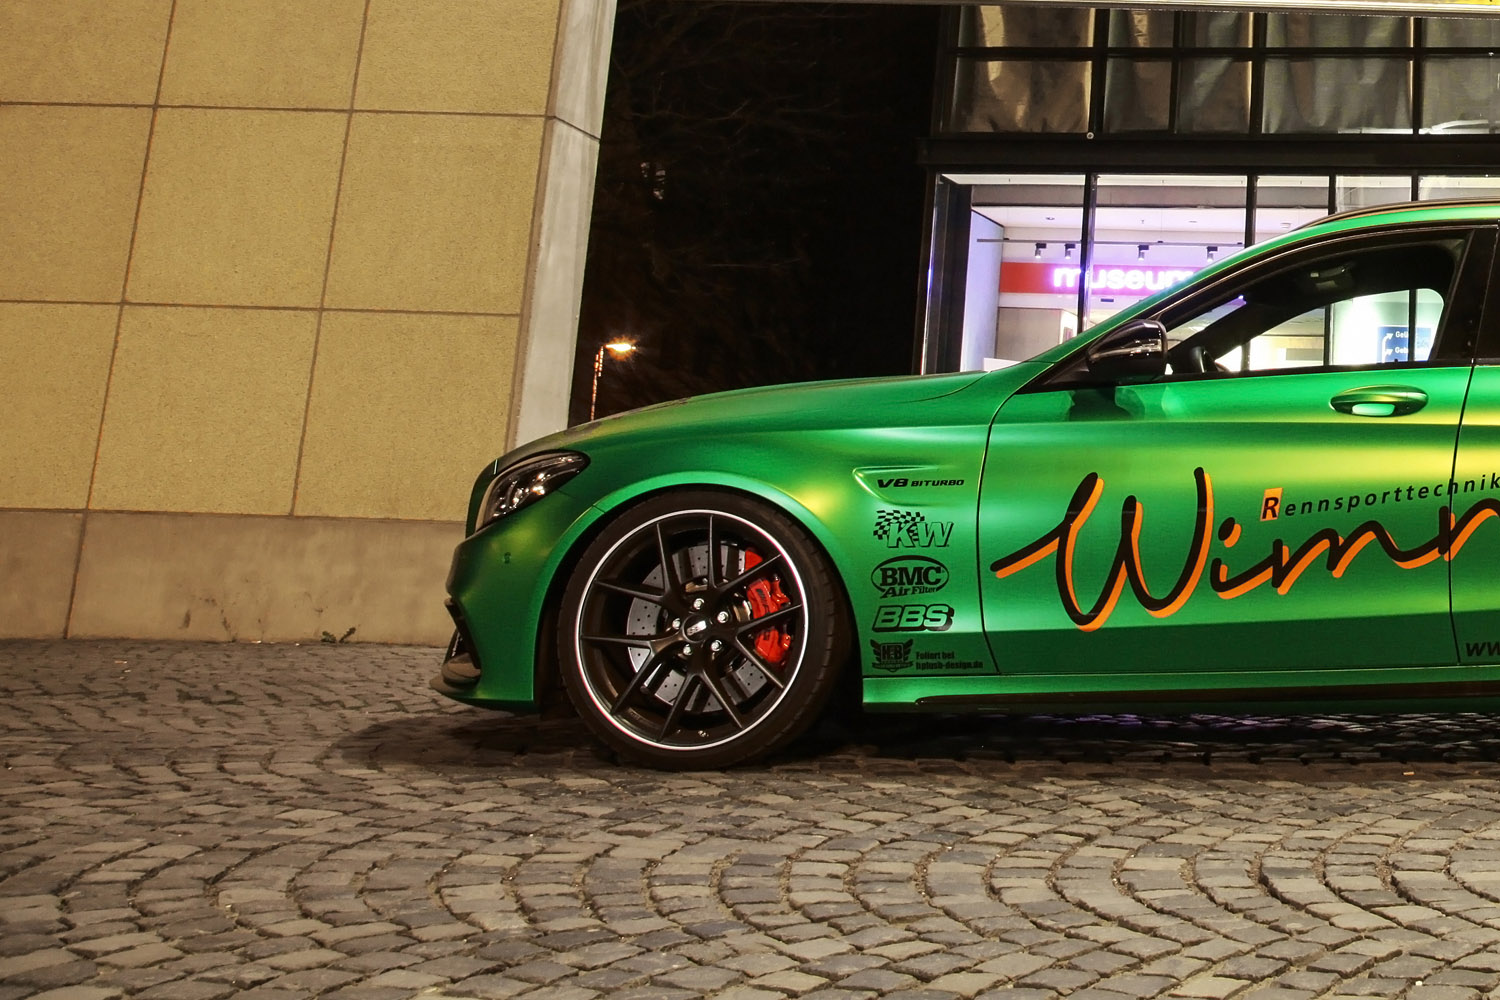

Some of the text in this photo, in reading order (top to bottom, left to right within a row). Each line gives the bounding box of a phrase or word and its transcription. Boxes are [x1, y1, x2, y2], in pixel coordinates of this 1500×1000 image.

[877, 478, 965, 489] V8 BITURBO
[886, 521, 955, 549] KW
[880, 566, 942, 587] BMC
[880, 586, 911, 599] Air
[872, 603, 955, 633] BBS
